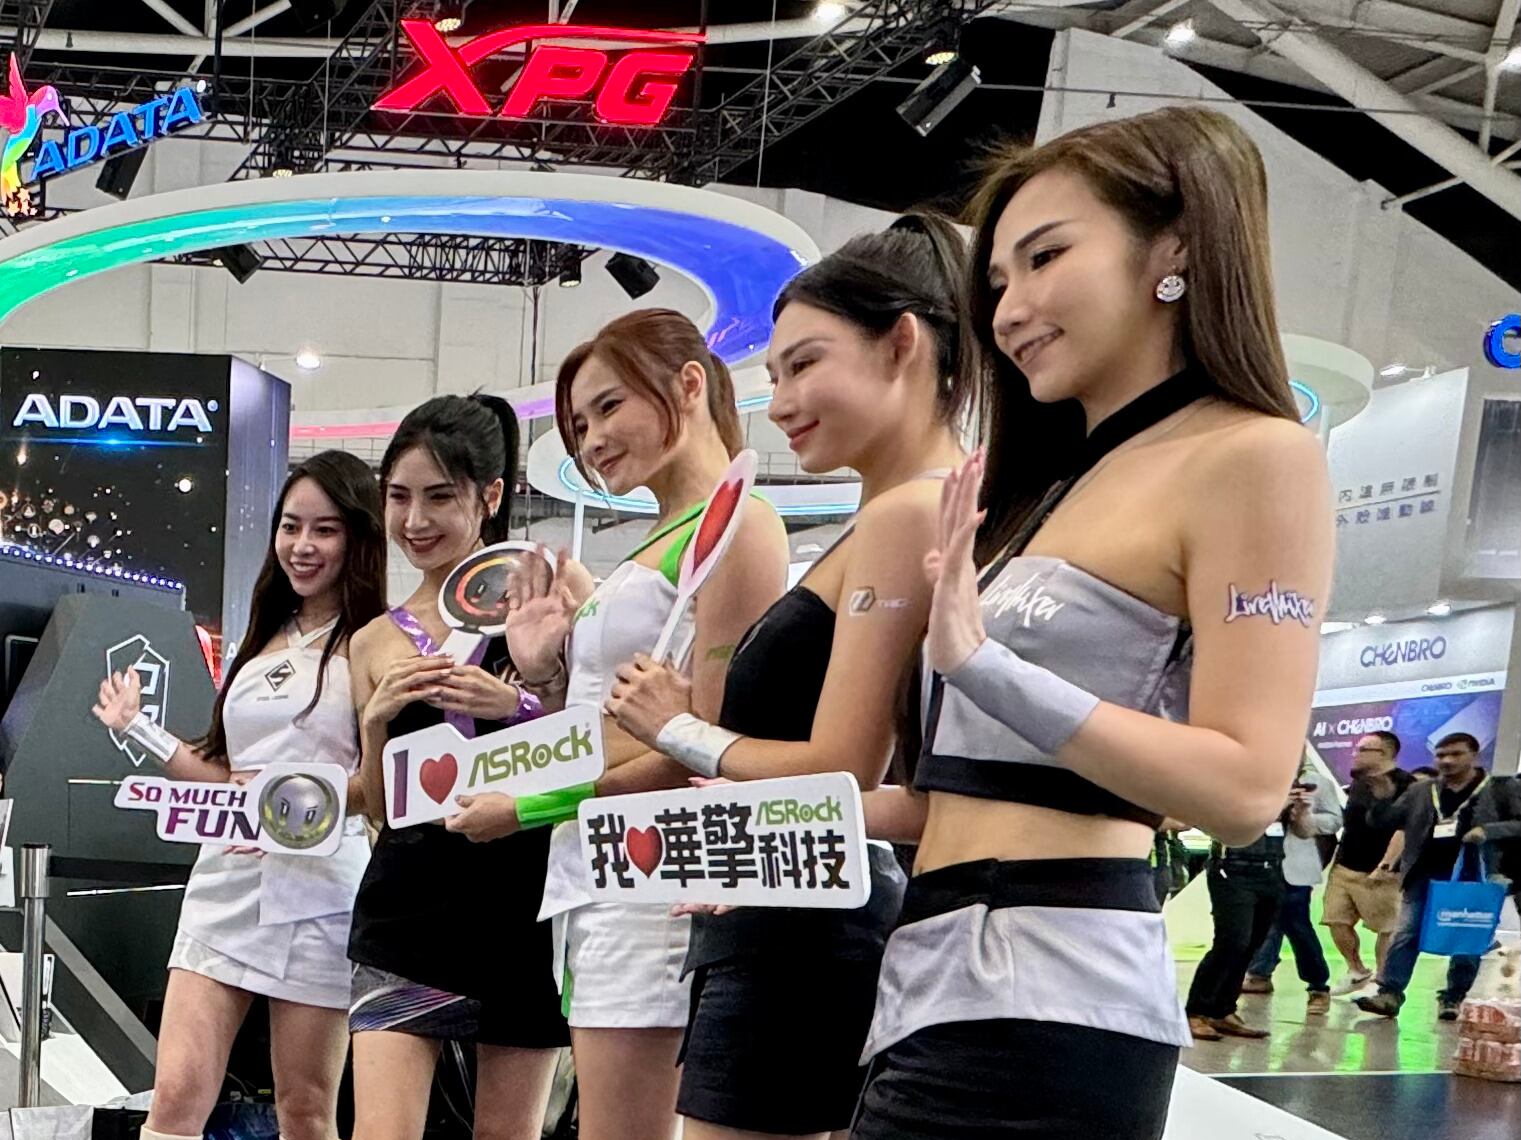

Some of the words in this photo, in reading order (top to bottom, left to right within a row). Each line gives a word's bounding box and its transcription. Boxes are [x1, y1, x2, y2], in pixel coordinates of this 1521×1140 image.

[369, 19, 706, 126] XPG
[31, 86, 203, 183] ADATA
[13, 393, 218, 433] ADATA
[1360, 635, 1447, 668] CHENBRO
[392, 749, 410, 820] I
[467, 724, 594, 788] ASRock
[168, 787, 248, 807] MUCH
[755, 796, 844, 826] ASRock
[165, 807, 263, 841] FUN
[587, 813, 636, 889] 我
